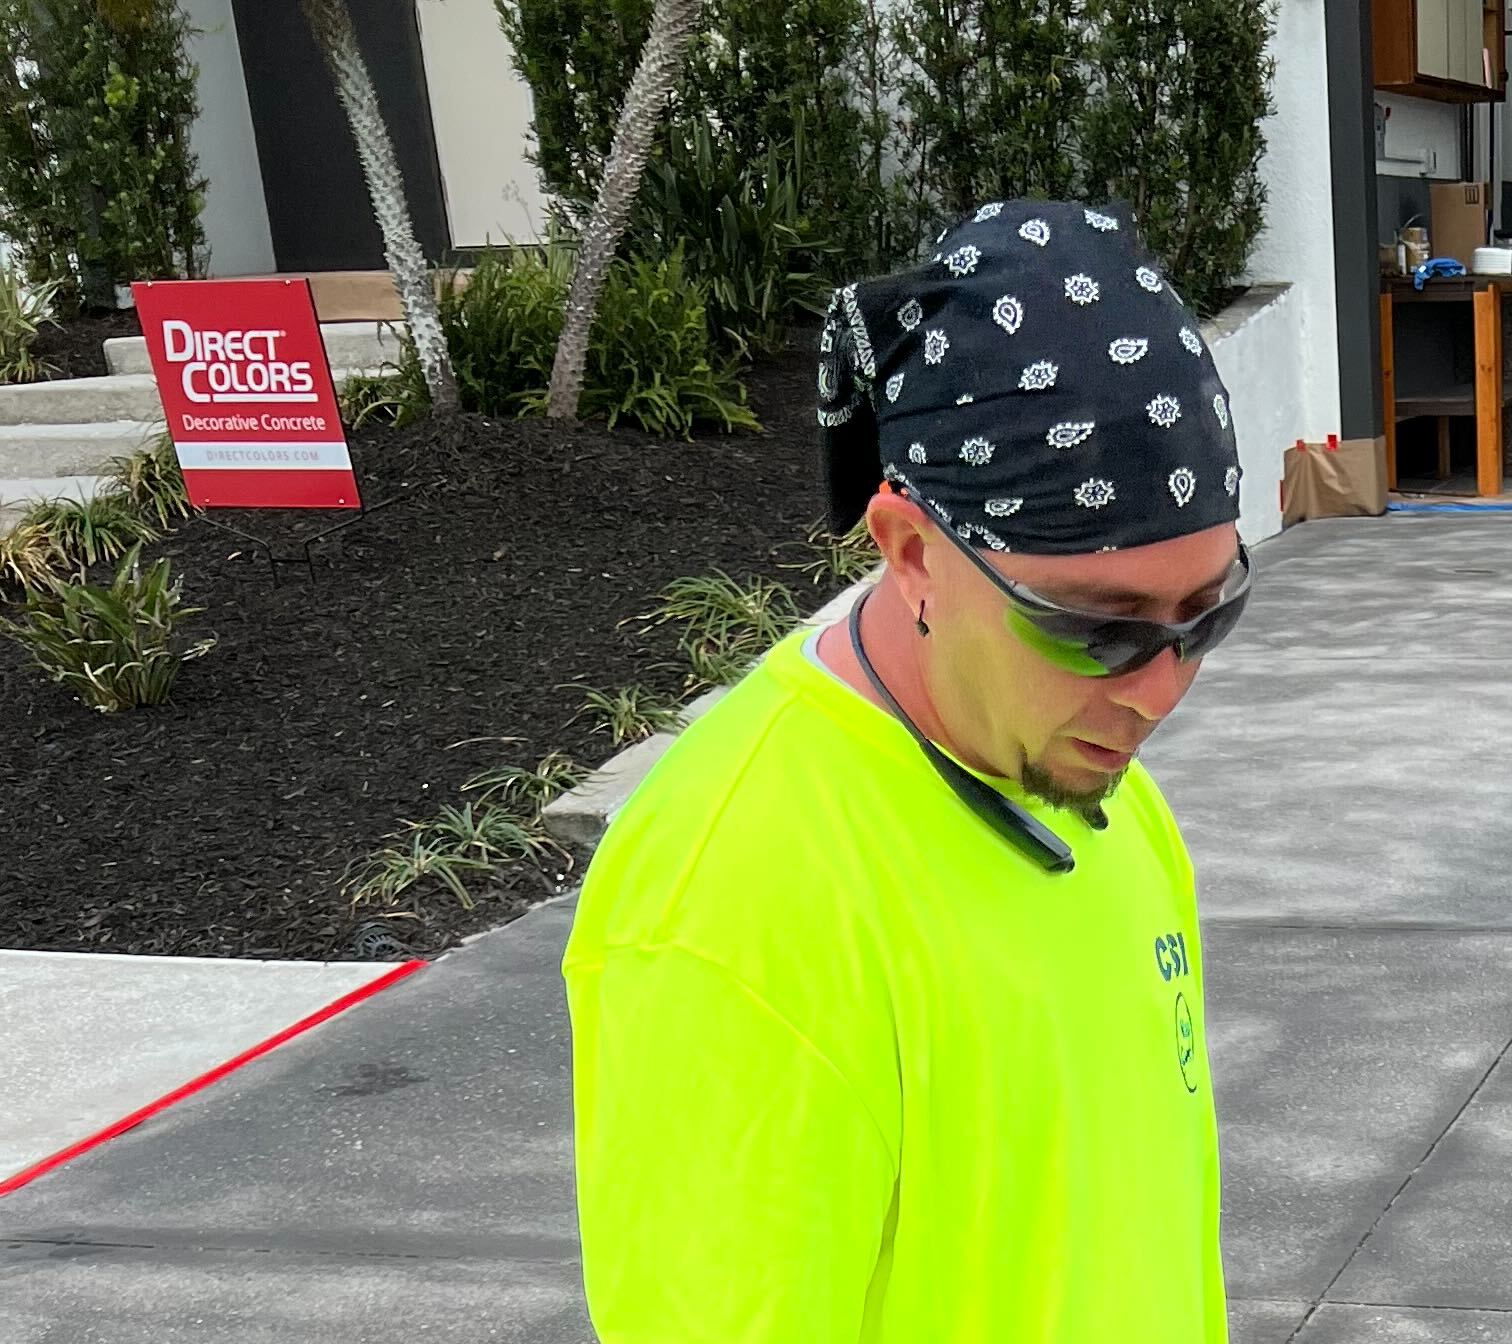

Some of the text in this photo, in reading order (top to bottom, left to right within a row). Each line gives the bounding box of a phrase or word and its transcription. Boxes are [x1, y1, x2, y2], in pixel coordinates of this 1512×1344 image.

[182, 361, 315, 402] COLORS
[182, 413, 326, 431] Decorative Concrete
[206, 450, 321, 461] DIRECTCOLORSCOM
[1155, 932, 1189, 982] CSI
